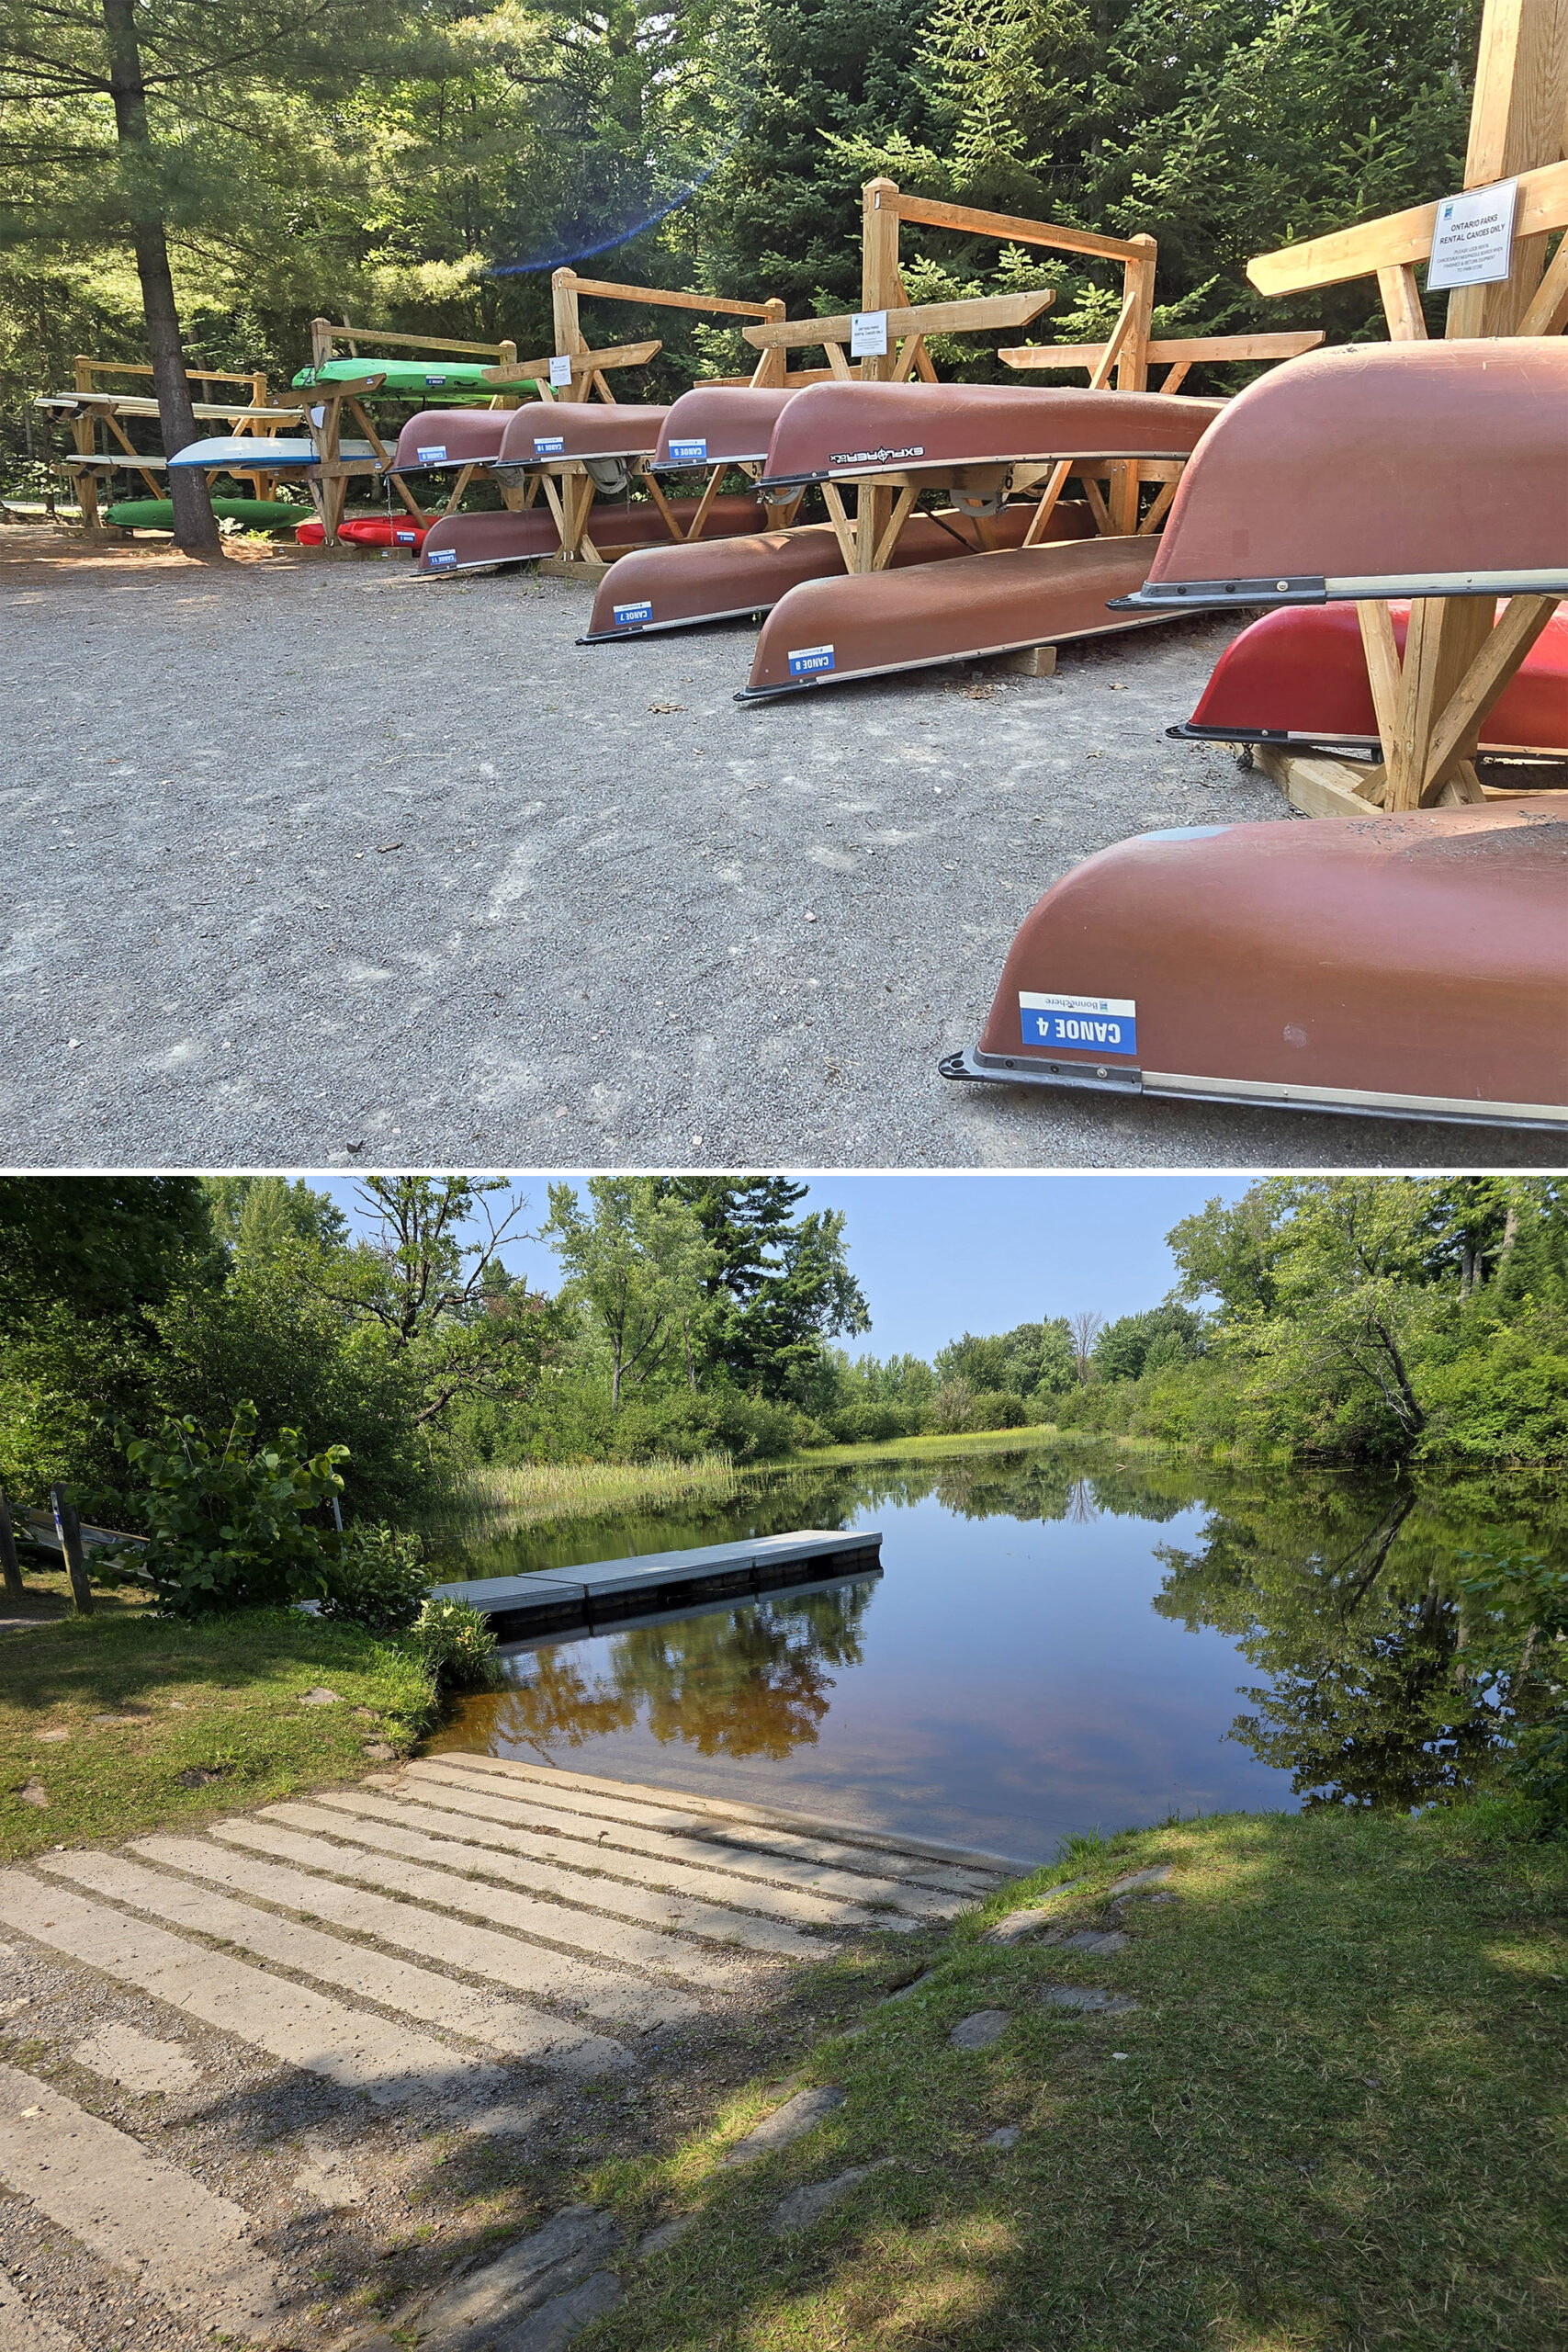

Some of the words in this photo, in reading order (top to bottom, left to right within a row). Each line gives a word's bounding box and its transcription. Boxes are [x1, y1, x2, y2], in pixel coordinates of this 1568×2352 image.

[1450, 220, 1480, 232] ONTARIO
[1480, 215, 1498, 225] PARKS
[1439, 234, 1465, 244] RENTAL
[1466, 229, 1490, 239] CANOES
[1490, 223, 1506, 234] ONLY
[682, 447, 702, 456] CANOE
[846, 447, 924, 463] EXPLORER
[620, 613, 625, 621] 7
[626, 610, 648, 620] CANOE
[795, 661, 801, 671] 8
[802, 656, 829, 669] CANOE
[1036, 1016, 1049, 1036] 4
[1054, 1018, 1122, 1044] CANOE
